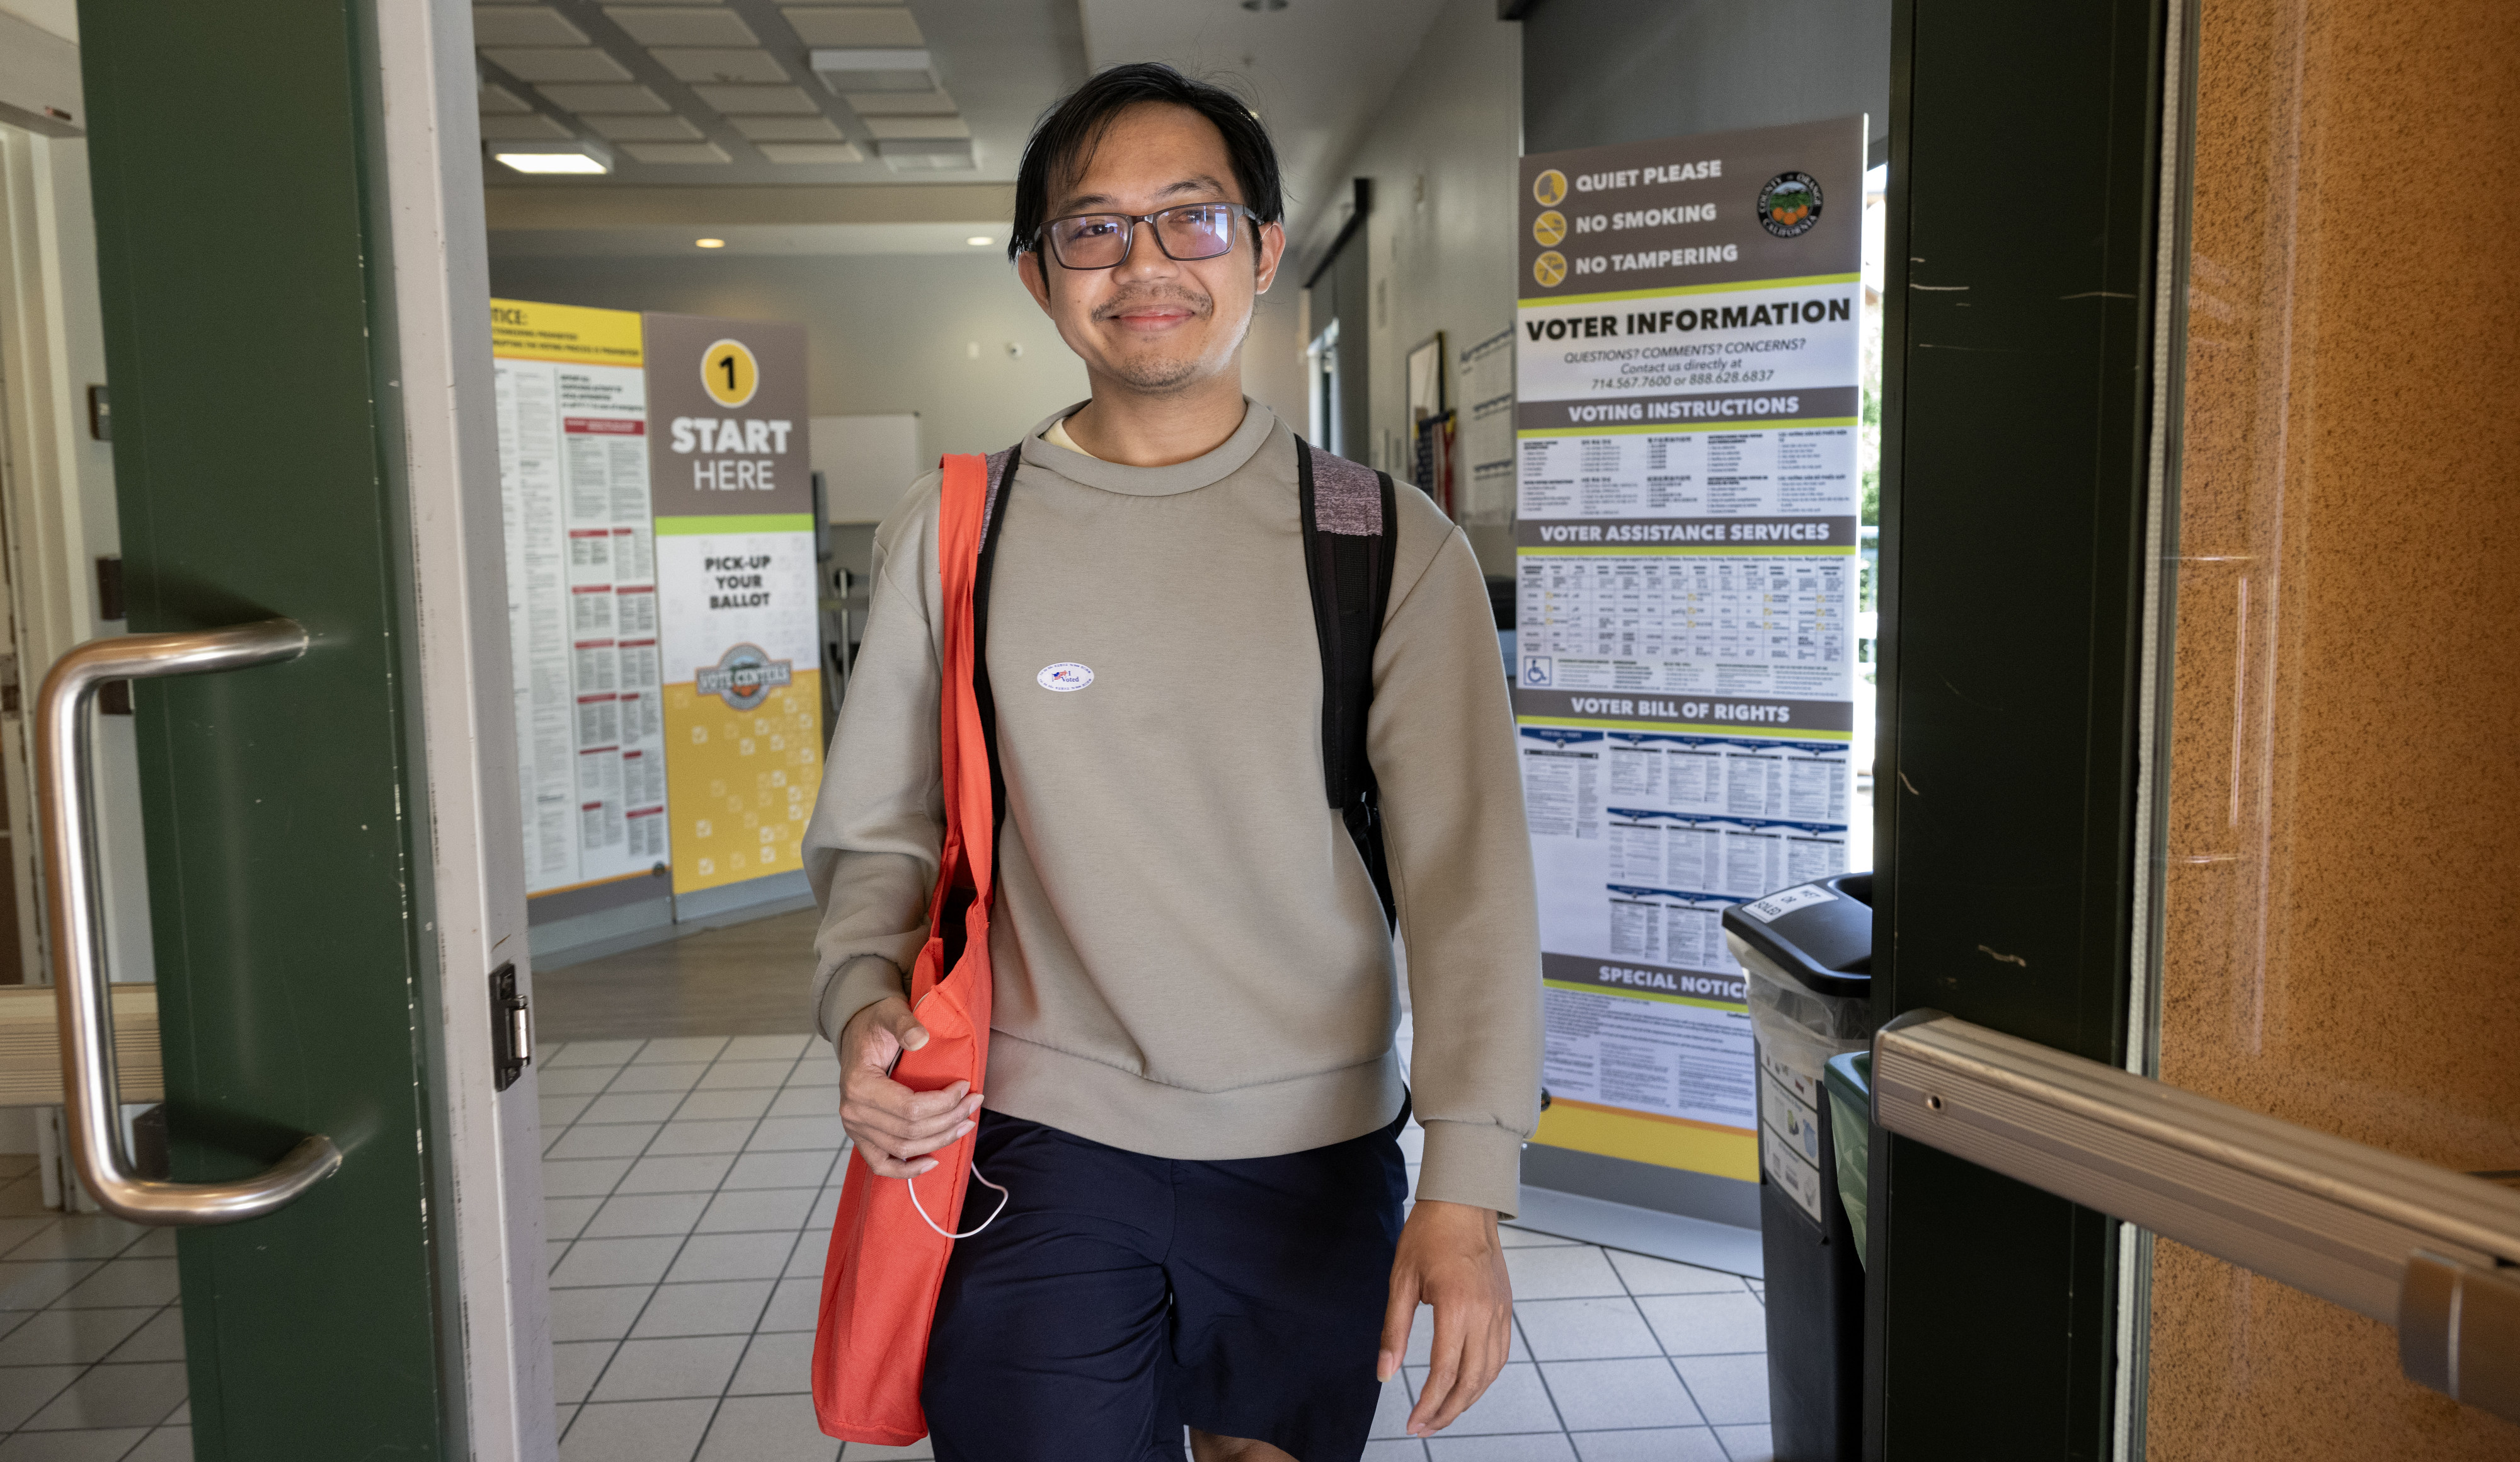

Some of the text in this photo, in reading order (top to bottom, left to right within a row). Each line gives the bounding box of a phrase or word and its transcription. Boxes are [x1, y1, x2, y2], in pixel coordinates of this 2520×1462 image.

[1576, 160, 1722, 190] QUIET PLEASE
[1576, 204, 1717, 234] NO SMOKING
[1763, 216, 1818, 238] CALIFORNIA
[1576, 244, 1738, 275] NO TAMPERING
[491, 308, 528, 325] TICE:
[1526, 298, 1851, 342] VOTER INFORMATION
[1564, 338, 1807, 365] QUESTIONS? COMMENTS? CONCERNS?
[719, 355, 735, 391] 1
[1592, 371, 1775, 389] 714.567.7600 or 888.628.6837
[1621, 359, 1743, 375] Contact us directly at
[1569, 396, 1799, 423] VOTING INSTRUCTIONS
[671, 417, 792, 454] START
[694, 460, 776, 491] HERE
[1540, 524, 1830, 541] VOTER ASSISTANCE SERVICES
[704, 556, 771, 572] PICK-UP
[716, 575, 763, 589] YOUR
[709, 593, 770, 609] BALLOT
[1571, 698, 1790, 722] VOTER BILL OF RIGHTS
[1599, 965, 1749, 998] SPECIAL NOTIC
